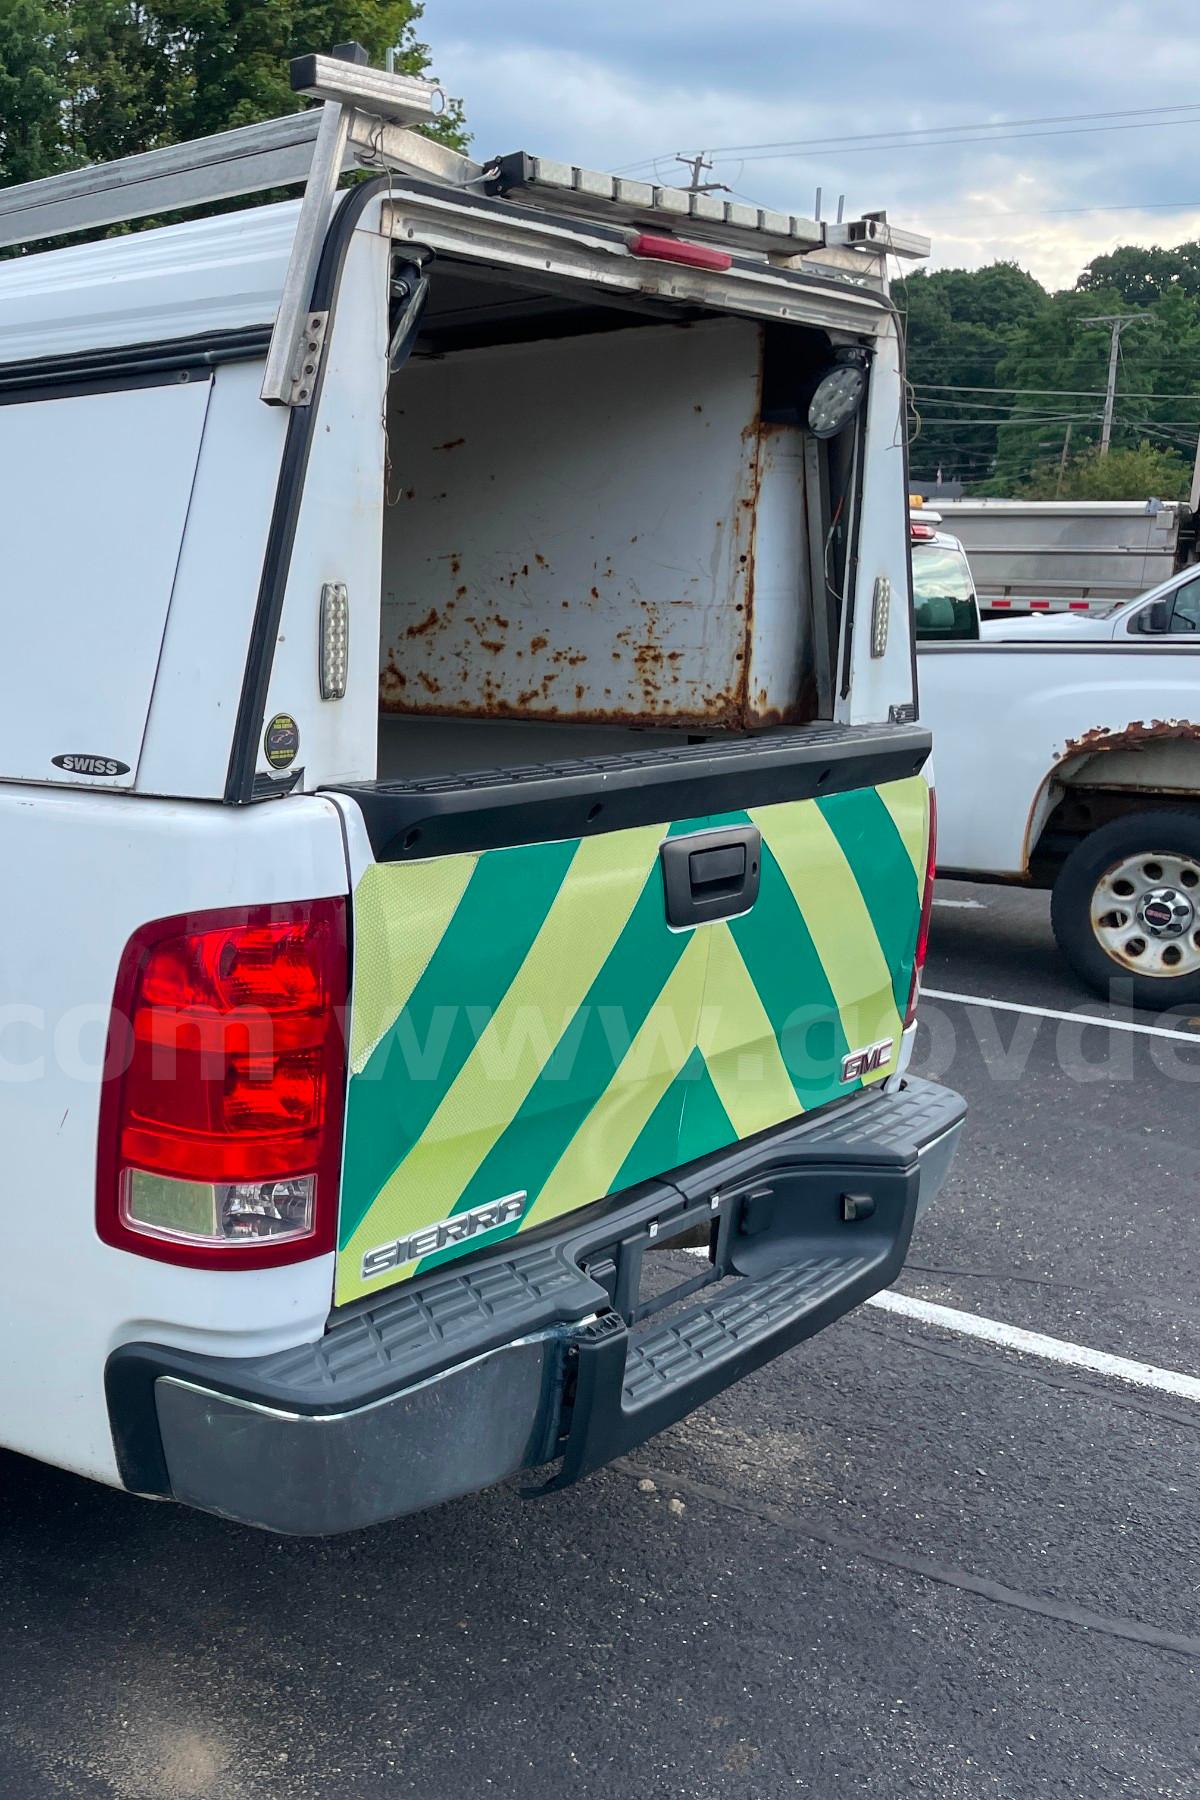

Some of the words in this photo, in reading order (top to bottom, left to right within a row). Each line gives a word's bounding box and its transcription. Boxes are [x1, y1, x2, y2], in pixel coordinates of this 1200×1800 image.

[62, 756, 118, 775] SWISS
[841, 1038, 894, 1082] GMC
[362, 1190, 528, 1280] SIERRA
